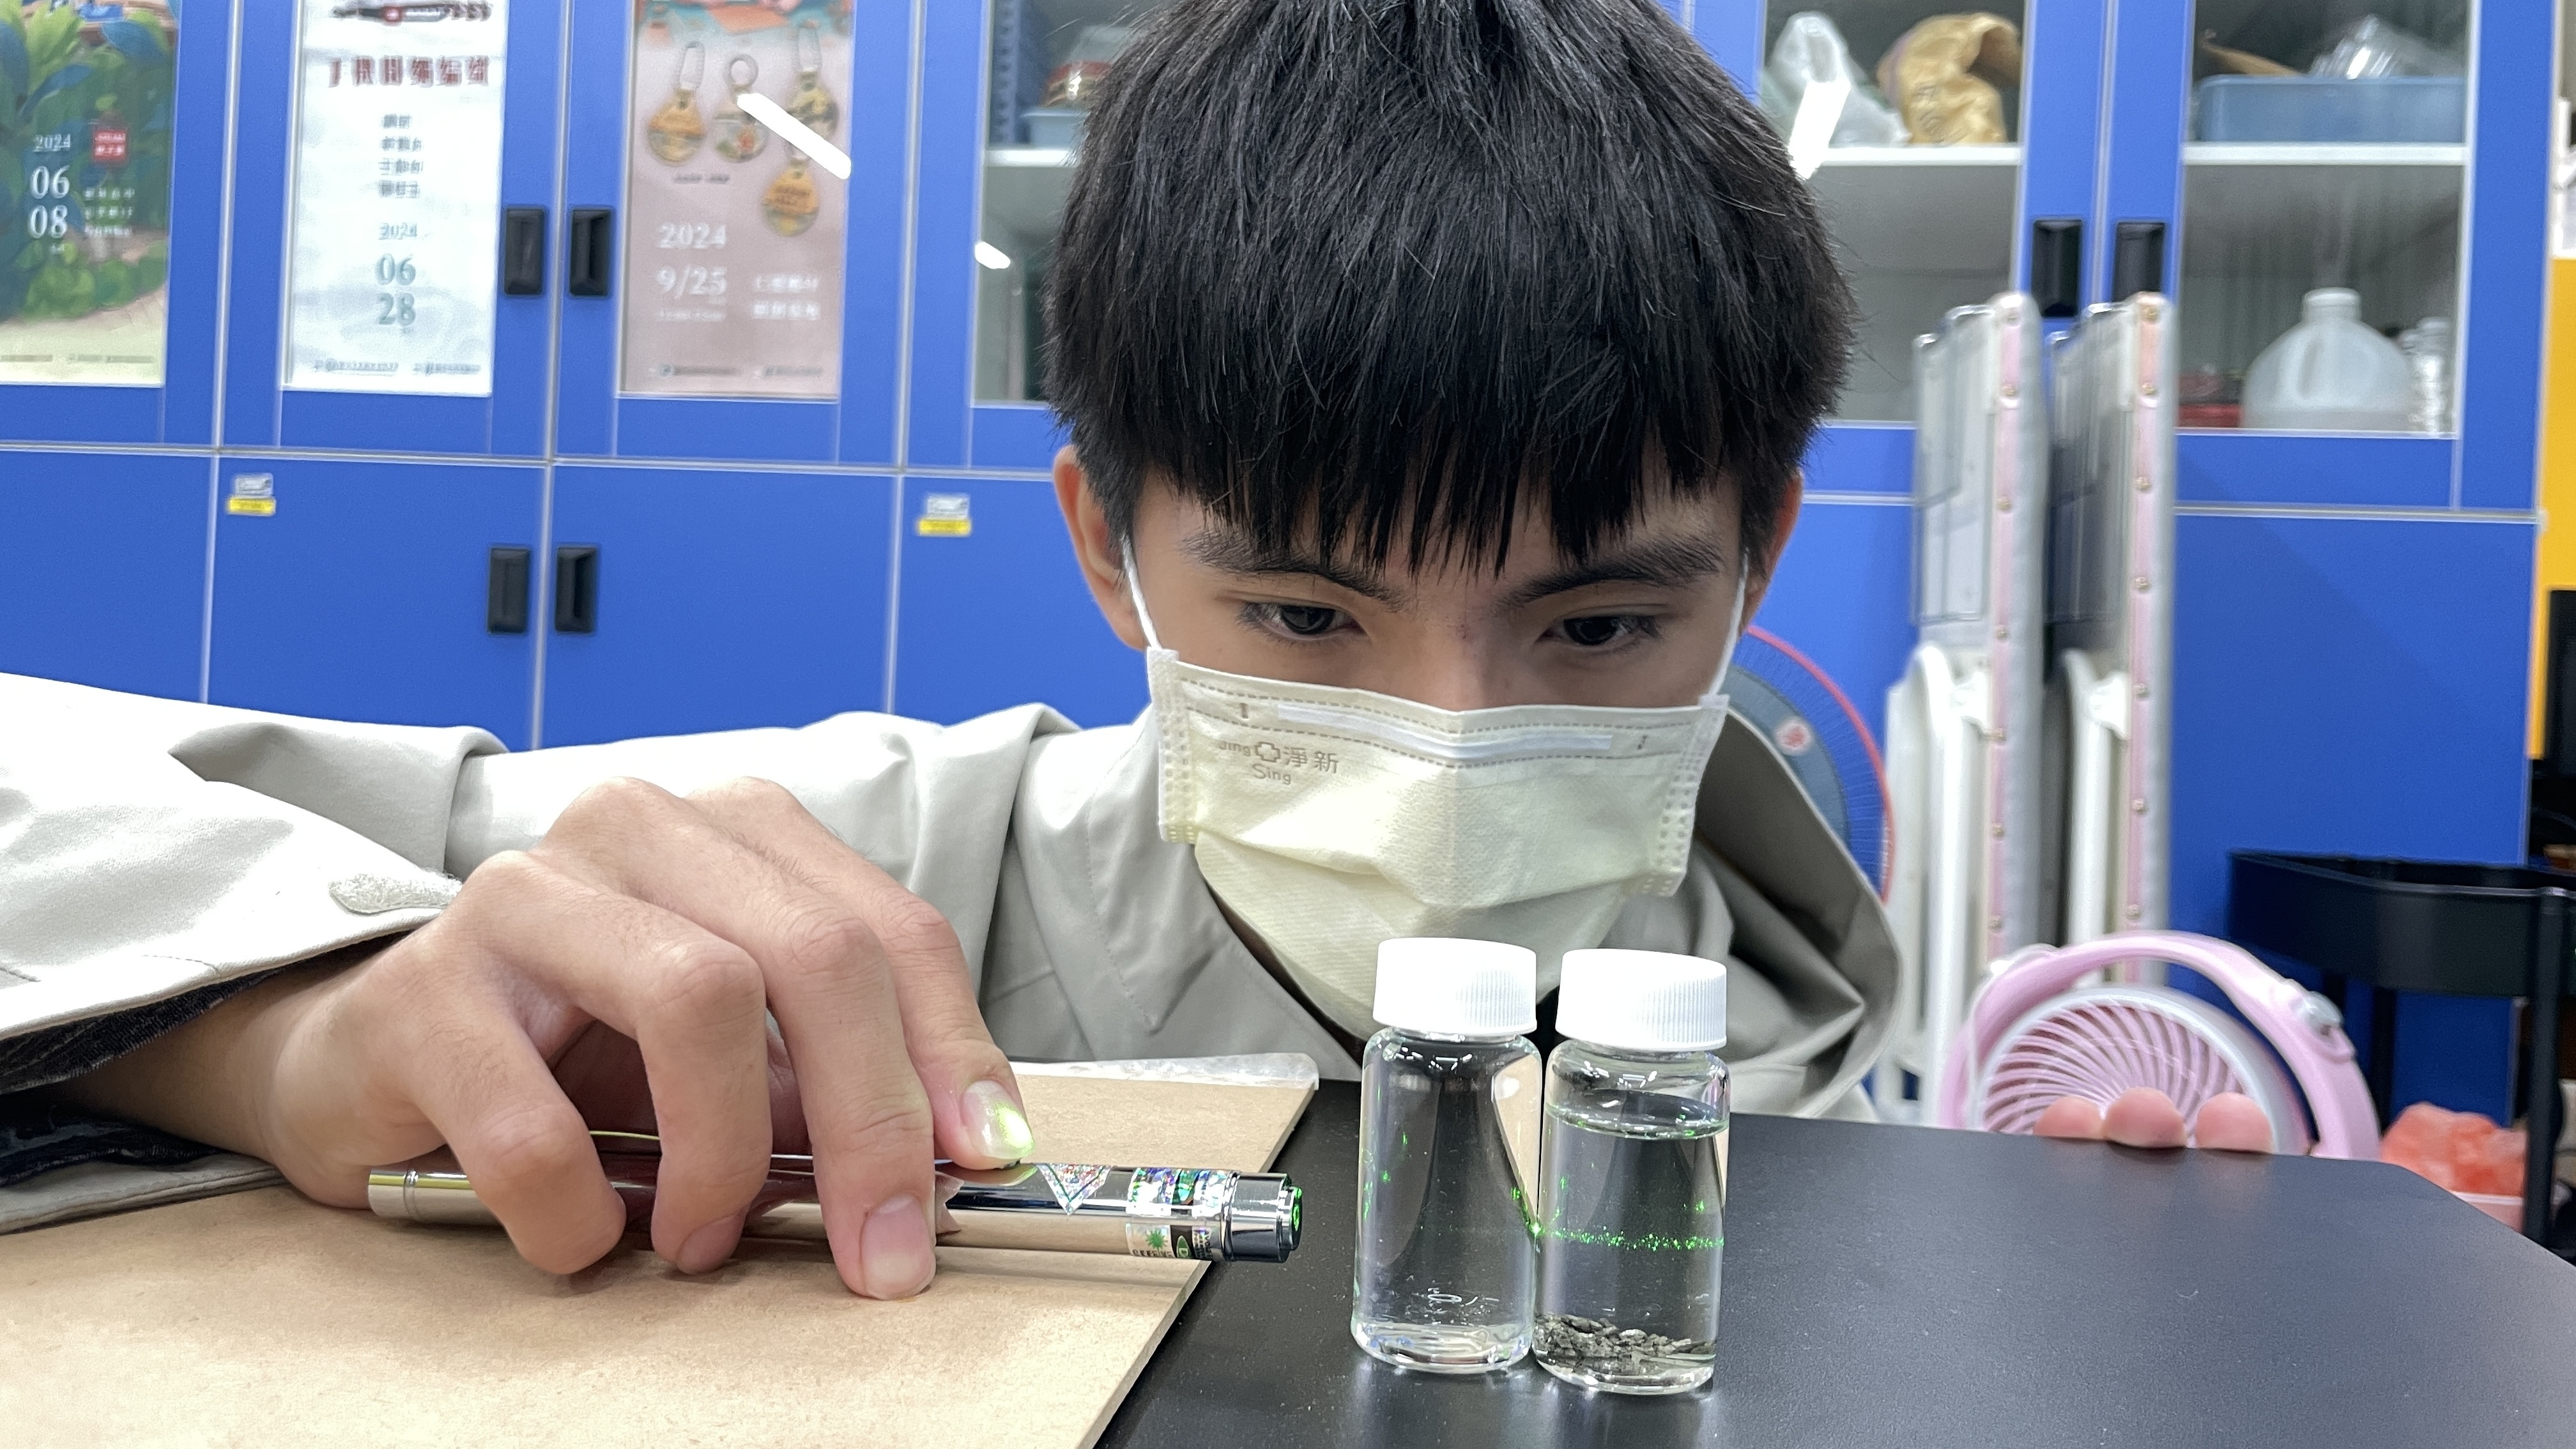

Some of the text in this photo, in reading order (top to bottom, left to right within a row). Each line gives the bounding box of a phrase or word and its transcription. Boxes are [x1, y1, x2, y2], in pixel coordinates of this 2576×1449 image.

[33, 134, 71, 152] 2024
[31, 165, 70, 199] 06
[30, 204, 68, 238] 08
[659, 223, 726, 249] 2024
[376, 253, 416, 286] 06
[656, 264, 727, 300] 9/25
[378, 292, 416, 326] 28
[1252, 763, 1292, 785] Sing
[1283, 746, 1339, 774] 淨新
